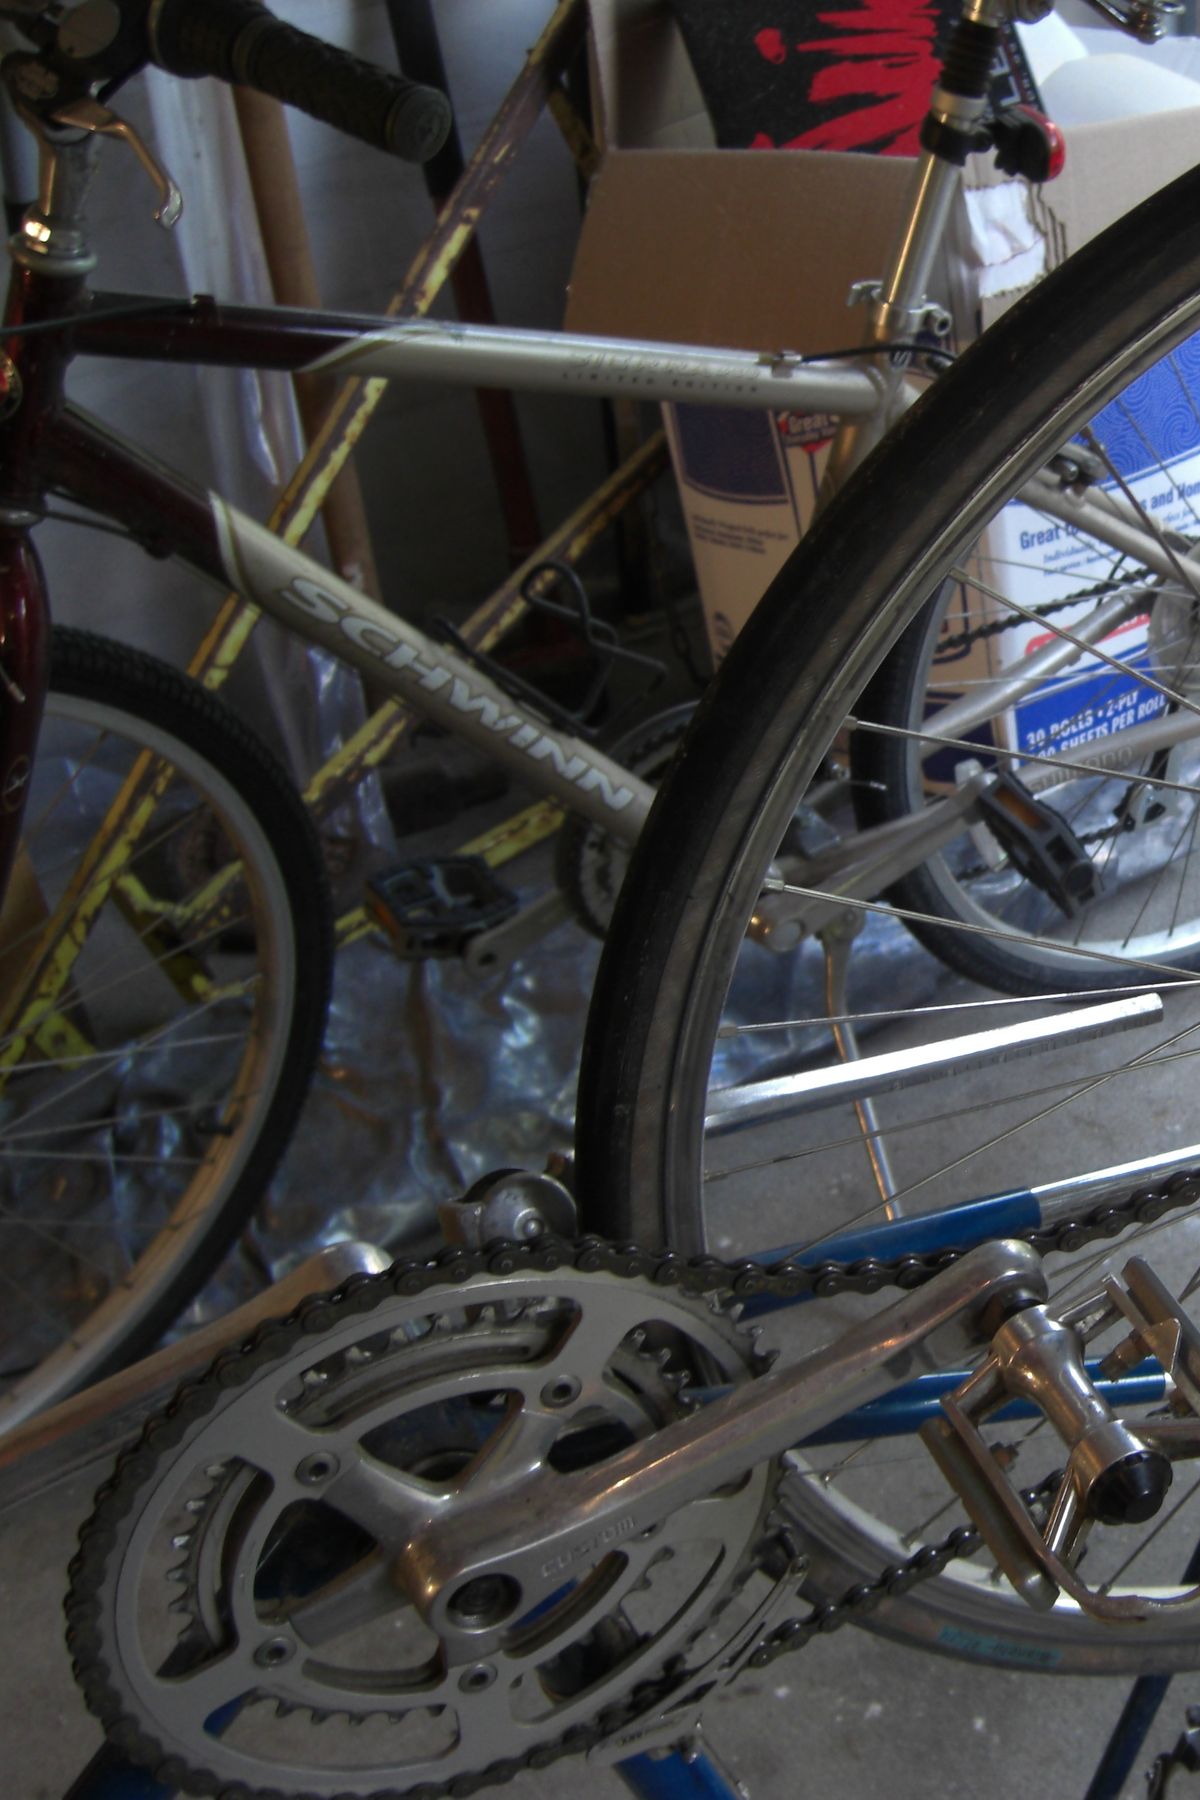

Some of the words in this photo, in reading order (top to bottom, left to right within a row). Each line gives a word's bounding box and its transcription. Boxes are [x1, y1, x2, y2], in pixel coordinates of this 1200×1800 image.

[1020, 527, 1061, 550] Great
[1151, 487, 1174, 510] and
[280, 576, 635, 811] SCHWINN
[1026, 727, 1046, 751] 30
[1050, 709, 1094, 740] ROLLS
[1106, 690, 1139, 718] 2-PLY
[1060, 721, 1109, 751] SHEETS
[1111, 708, 1135, 734] PER
[1137, 693, 1167, 720] ROLL
